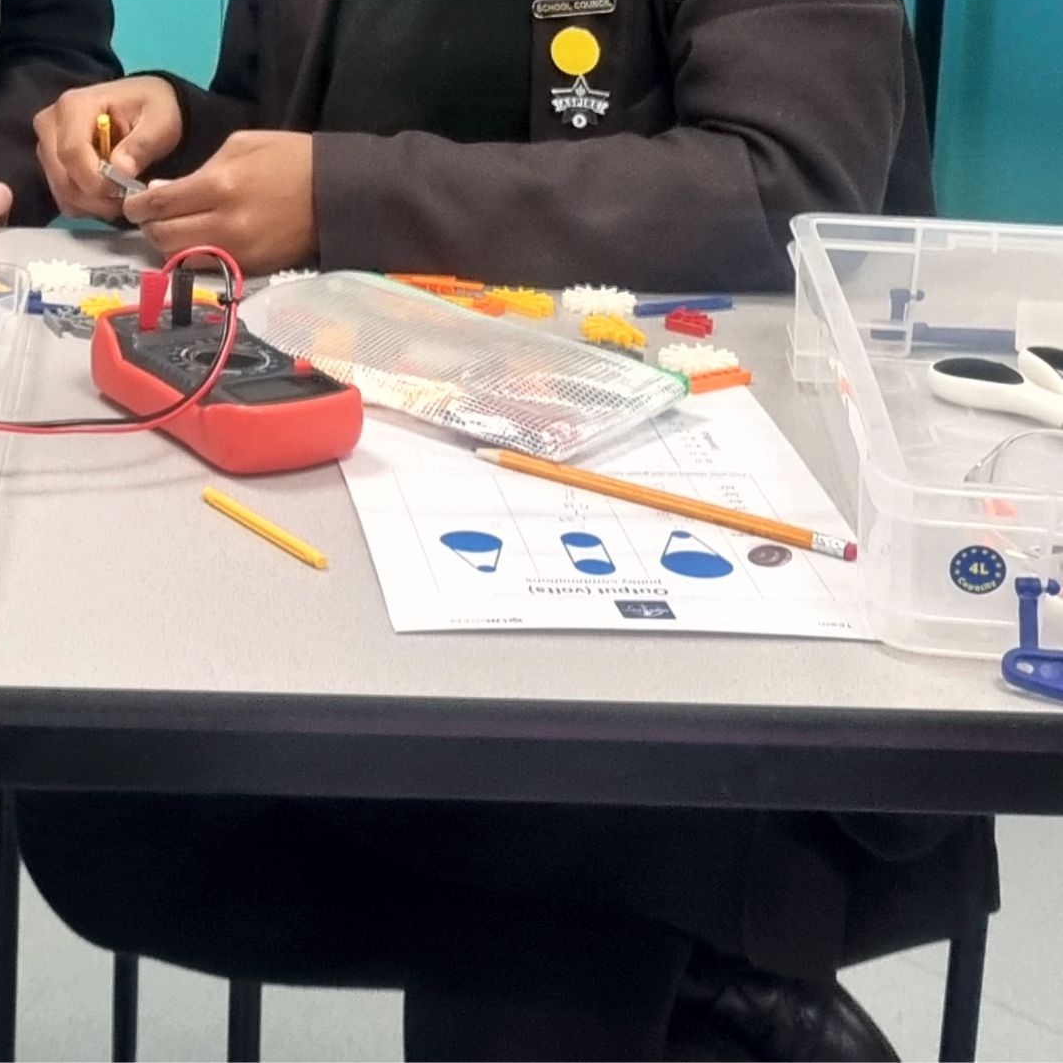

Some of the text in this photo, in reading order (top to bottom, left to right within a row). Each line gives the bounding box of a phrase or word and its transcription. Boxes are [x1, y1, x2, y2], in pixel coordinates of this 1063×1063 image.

[536, 2, 573, 14] SCHOOL
[969, 562, 989, 575] 4L
[528, 586, 669, 596] Output (volts)
